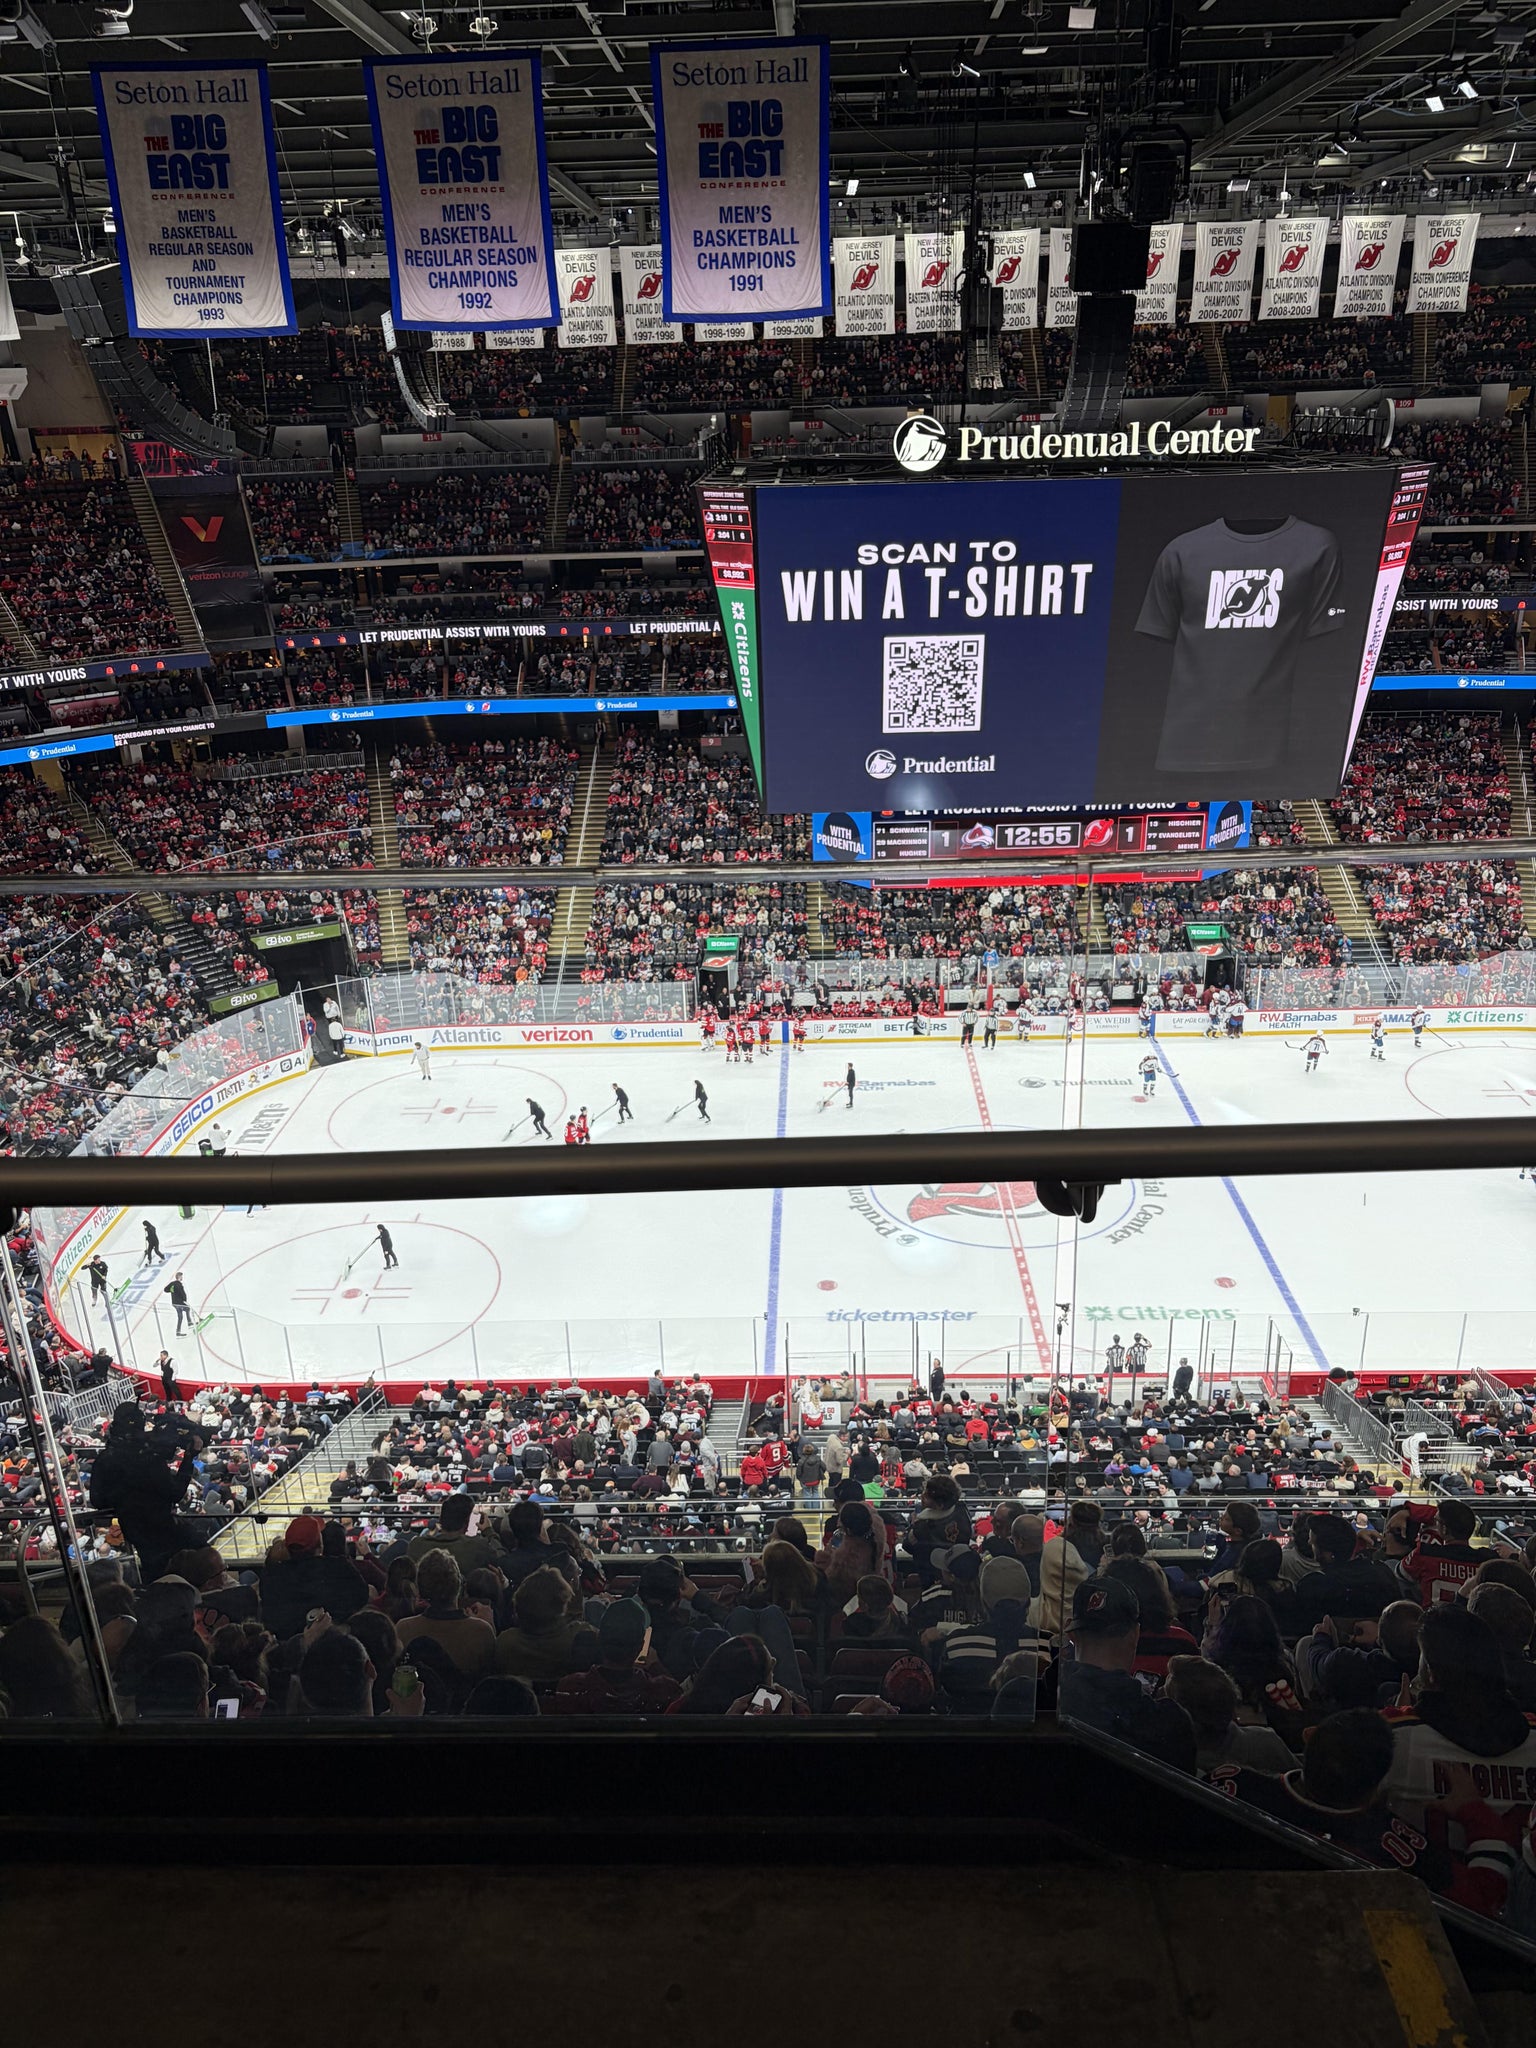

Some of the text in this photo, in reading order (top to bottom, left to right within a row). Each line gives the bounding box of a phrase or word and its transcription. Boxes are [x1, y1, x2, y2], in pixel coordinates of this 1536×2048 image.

[673, 58, 808, 86] Seton Hall
[387, 68, 521, 98] Seton Hall
[115, 78, 248, 104] Seton Hall
[414, 105, 498, 144] THE BIG
[698, 99, 782, 138] THE BIG
[144, 114, 227, 151] THE BIG
[416, 145, 501, 184] EAST
[699, 140, 784, 178] EAST
[146, 152, 230, 189] EAST
[421, 187, 505, 195] CONFERENCE
[700, 180, 786, 189] CONFERENCE
[178, 210, 216, 222] MEN'S
[442, 204, 490, 222] MEN'S
[719, 205, 771, 223] MEN'S
[162, 226, 237, 239] BASKETBALL
[420, 226, 517, 245] BASKETBALL
[693, 227, 799, 247] BASKETBALL
[1281, 231, 1312, 243] DEVILS
[1357, 229, 1388, 241] DEVILS
[1429, 227, 1461, 238] DEVILS
[860, 241, 883, 249] JERSEY
[1211, 236, 1243, 247] DEVILS
[149, 243, 253, 256] REGULAR SEASON
[849, 250, 880, 261] DEVILS
[994, 244, 1024, 255] DEVILS
[405, 246, 537, 267] REGULAR SEASON
[698, 250, 796, 269] CHAMPIONS
[192, 259, 216, 272] AND
[565, 262, 596, 273] DEVILS
[166, 276, 245, 289] TOURNAMENT
[429, 270, 517, 288] CHAMPIONS
[729, 275, 763, 291] 1991
[1264, 275, 1319, 289] ATLANTIC DIVISION
[1340, 274, 1394, 287] ATLANTIC DIVISION
[1412, 271, 1469, 284] EASTERN CONFERENCE
[1010, 287, 1036, 298] DIVISION
[1150, 283, 1176, 294] DIVISION
[1195, 280, 1251, 293] ATLANTIC DIVISION
[1417, 286, 1461, 299] CHAMPIONS
[173, 292, 243, 305] CHAMPIONS
[458, 293, 492, 309] 1992
[837, 294, 893, 306] ATLANTIC DIVISION
[1204, 295, 1240, 307] CHAMPIONS
[1273, 292, 1308, 304] CHAMPIONS
[1348, 289, 1383, 301] CHAMPIONS
[586, 305, 613, 317] DIVISION
[625, 303, 650, 315] ATLANTIC
[1267, 306, 1312, 316] 2008-2009
[1342, 303, 1386, 314] 2009-2010
[1416, 301, 1459, 310] 2011-2012
[198, 308, 224, 320] 1993
[847, 308, 883, 321] CHAMPIONS
[1198, 309, 1244, 319] 2006-2007
[568, 320, 604, 332] CHAMPIONS
[772, 325, 814, 336] 1999-2000
[845, 322, 887, 333] 2000-2001
[566, 333, 608, 344] 1996-1997
[633, 331, 675, 341] 1997-1998
[703, 328, 746, 339] 1998-1999
[493, 337, 535, 347] 1994-1995
[1399, 400, 1411, 408] 109
[1212, 407, 1224, 416] 110
[808, 422, 820, 430] 112
[957, 420, 1261, 462] Prudential Center
[857, 541, 1017, 565] SCAN TO
[188, 570, 249, 581] verizon lounge
[781, 563, 1093, 622] WIN A T-SHIRT
[1429, 598, 1499, 610] WITH YOURS
[360, 625, 546, 643] LET PRUDENTIAL ASSIST WITH YOURS
[630, 623, 647, 634] LET
[650, 622, 711, 633] PRUDENTIAL
[734, 623, 752, 699] Citizens
[14, 672, 45, 688] WITH
[49, 667, 87, 684] YOURS
[1471, 679, 1505, 687] Prudential
[607, 701, 638, 709] Prudential
[341, 709, 374, 719] Prudential
[114, 729, 152, 741] SCOREBOARD
[153, 728, 165, 736] FOR
[165, 726, 183, 734] YOUR
[183, 724, 206, 732] CHANCE
[708, 738, 714, 746] 9
[41, 744, 76, 756] Prudential
[903, 755, 995, 775] Prudential
[1221, 814, 1238, 831] WITH
[829, 824, 852, 840] WITH
[1004, 826, 1072, 846] 12:55
[1126, 827, 1134, 843] 1
[1209, 822, 1247, 847] PRUDENTIAL
[816, 833, 867, 856] PRUDENTIAL
[942, 832, 950, 847] 1
[1464, 1011, 1524, 1023] Citizens
[431, 1029, 502, 1045] Atlantic
[521, 1027, 593, 1042] verizon
[630, 1028, 683, 1039] Prudential
[744, 1032, 751, 1040] 12
[358, 1034, 413, 1047] HYUNDAI
[173, 1095, 213, 1142] GEICO
[1105, 1203, 1165, 1245] Center
[61, 1229, 93, 1275] Citizens
[826, 1310, 977, 1322] ticketmaster
[1118, 1305, 1236, 1321] Citizens
[512, 1429, 529, 1447] 86
[772, 1448, 781, 1461] 9
